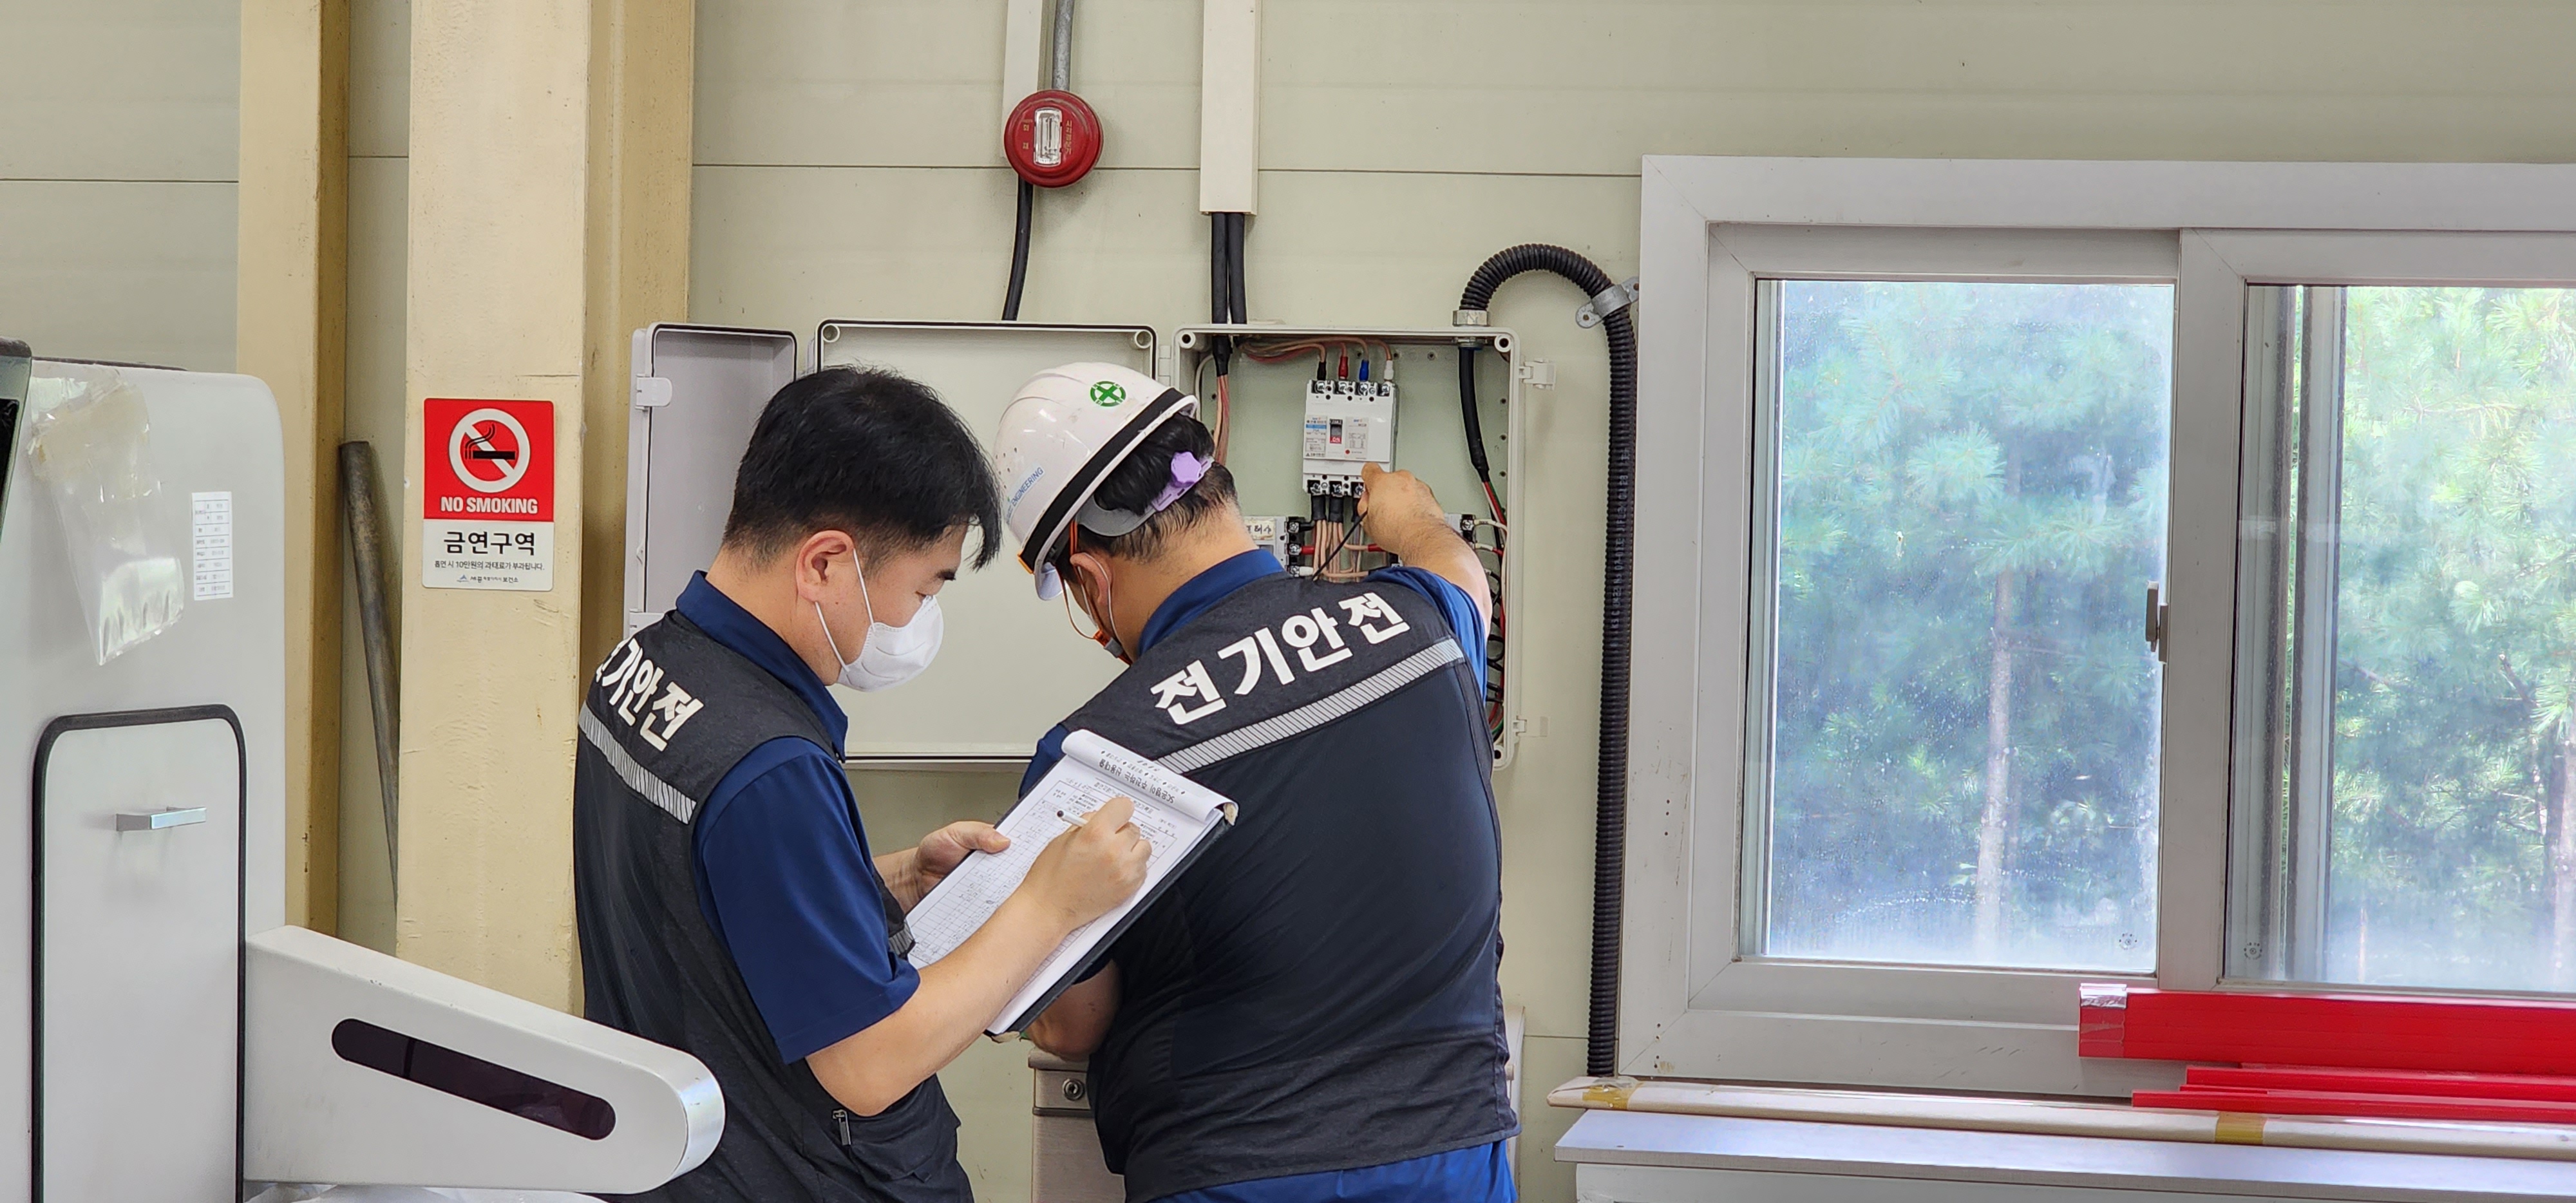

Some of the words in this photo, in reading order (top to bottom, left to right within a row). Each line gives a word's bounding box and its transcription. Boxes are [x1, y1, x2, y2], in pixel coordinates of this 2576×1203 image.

[1010, 466, 1044, 507] ENGINEERING
[440, 497, 463, 512] NO
[466, 497, 538, 514] SMOKING
[444, 531, 535, 556] 금연구역
[435, 560, 447, 569] 흡연
[455, 561, 484, 569] 10만원의
[484, 561, 511, 570] 과태료가
[513, 562, 545, 571] 부과됩니다.
[1150, 592, 1410, 725] 전기안전
[596, 638, 705, 752] 기안전
